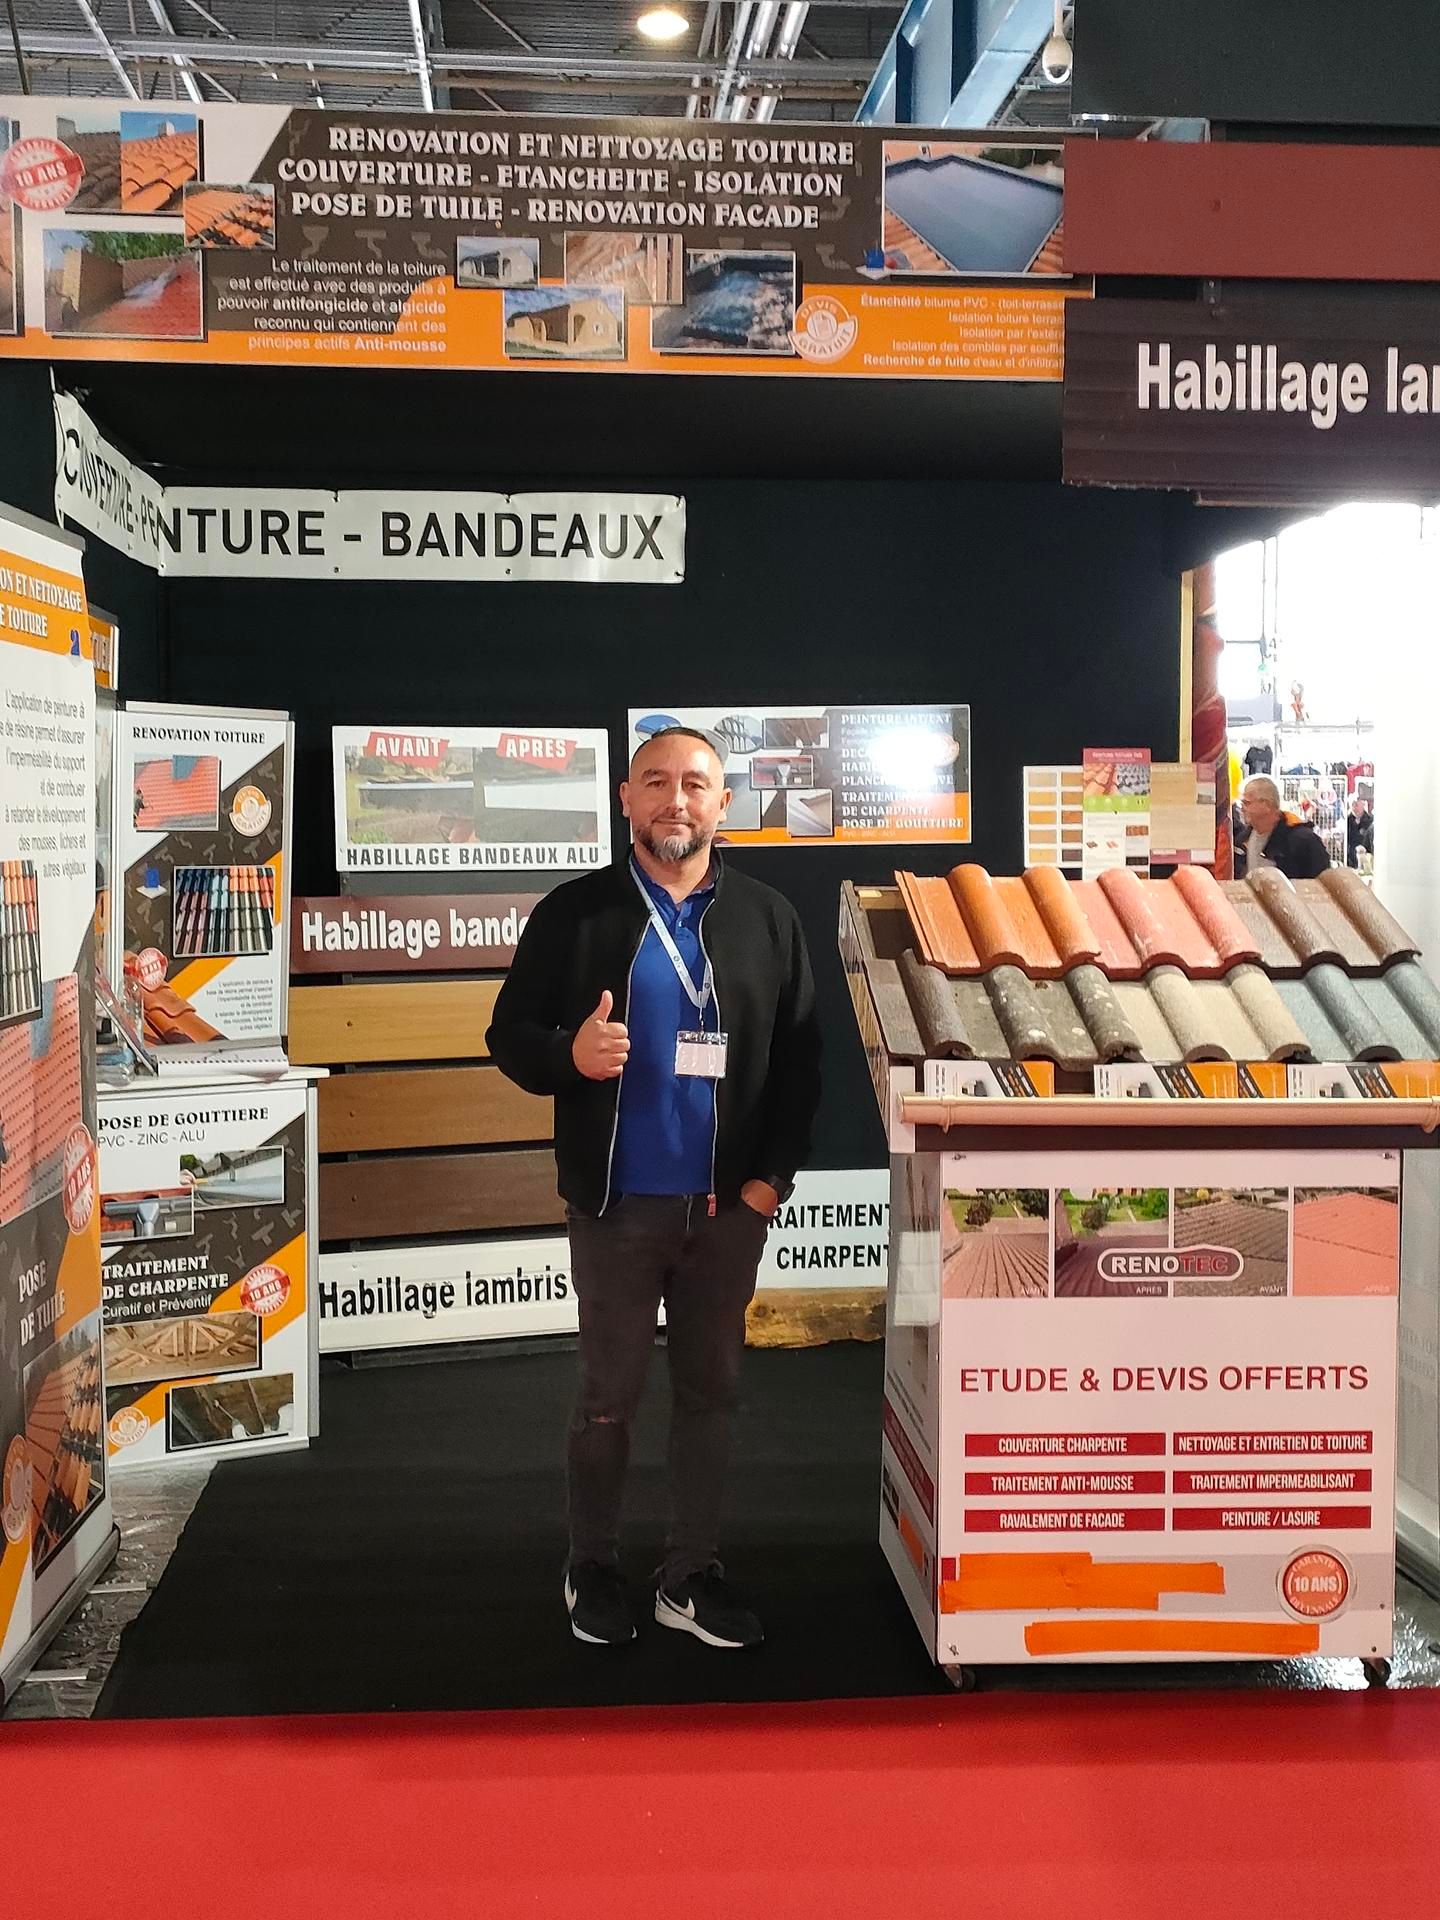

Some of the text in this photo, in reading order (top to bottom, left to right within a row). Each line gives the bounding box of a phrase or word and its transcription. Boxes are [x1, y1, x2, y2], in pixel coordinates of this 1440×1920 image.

[329, 126, 855, 166] RENOVATION ET NETTOYAGE TOITURE
[15, 161, 68, 187] 10 ANS
[277, 159, 472, 188] COUVERTURE
[496, 164, 668, 194] ETANCHEITE
[695, 171, 843, 197] ISOLATION
[291, 191, 366, 218] POSE
[375, 193, 414, 219] DE
[420, 195, 503, 222] TUILE
[527, 198, 705, 229] RENOVATION
[714, 202, 819, 230] FACADE
[272, 257, 447, 277] Le traitement de la toiture
[229, 277, 251, 292] est
[254, 277, 310, 293] effectué
[313, 280, 347, 294] avec
[350, 278, 376, 295] des
[378, 280, 434, 297] produits
[217, 297, 447, 318] pouvoir antifongicide et algicide
[963, 297, 989, 309] PVC
[253, 317, 447, 334] reconnu qui contiennent des
[248, 336, 447, 353] principes actifs Anti-mousse
[863, 353, 925, 366] Recherche
[928, 355, 941, 366] de
[945, 356, 970, 367] fuite
[1138, 342, 1370, 430] Habillage
[382, 511, 666, 561] BANDEAUX
[16, 571, 82, 613] ET NETTOYAGE
[7, 604, 48, 637] TOITURE
[132, 726, 265, 745] RENOVATION TOITURE
[375, 736, 568, 759] AVANT APRES
[842, 805, 858, 817] DE
[346, 845, 600, 866] HABILLAGE BANDEAUX ALU
[301, 909, 442, 960] Habillage
[98, 1106, 269, 1130] POSE DE GOUTTIERE
[97, 1134, 126, 1149] PVC
[137, 1131, 169, 1146] ZINC
[179, 1129, 206, 1143] ALU
[76, 1157, 91, 1188] ANS
[102, 1254, 209, 1281] TRAITEMENT
[1110, 1255, 1229, 1275] RENOTEC
[18, 1259, 47, 1303] POSE
[103, 1285, 125, 1301] DE
[129, 1272, 230, 1298] CHARPENTE
[1259, 1285, 1284, 1294] AVANT
[250, 1289, 262, 1302] 10
[319, 1276, 456, 1319] Habillage
[465, 1265, 568, 1307] lambris
[102, 1293, 213, 1320] Curatif et Préventif
[20, 1289, 66, 1347] DE TUILE
[959, 1367, 1068, 1393] ETUDE
[1079, 1367, 1101, 1393] &
[1112, 1366, 1209, 1392] DEVIS
[1218, 1365, 1370, 1391] OFFERTS
[998, 1436, 1128, 1453] COUVERTURE CHARPENTE
[1178, 1435, 1367, 1452] NETTOYAGE ET ENTRETIEN DE TOITURE
[991, 1475, 1135, 1492] TRAITEMENT ANTI-MOUSSE
[1190, 1473, 1355, 1490] TRAITEMENT IMPERMEABILISANT
[1000, 1512, 1125, 1529] RAVALEMENT DE FACADE
[1221, 1510, 1321, 1527] PEINTURE / LASURE
[1294, 1576, 1338, 1593] 10 ANS
